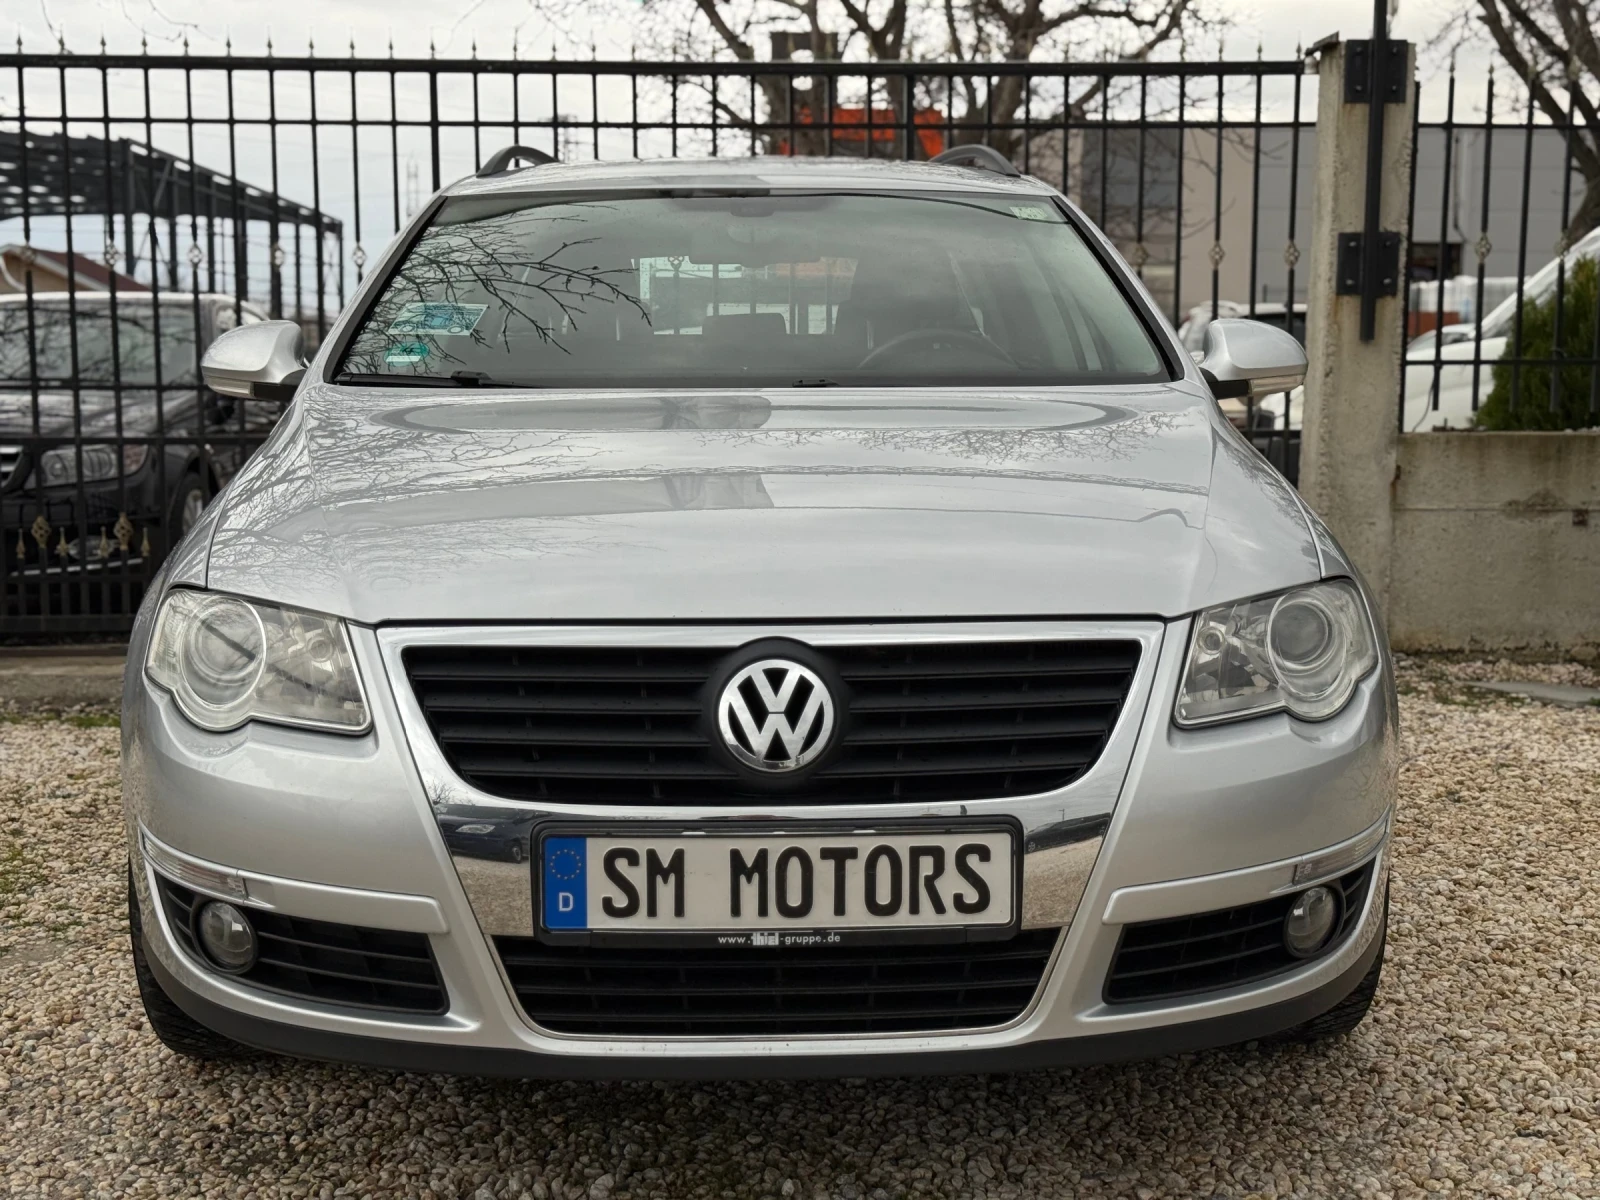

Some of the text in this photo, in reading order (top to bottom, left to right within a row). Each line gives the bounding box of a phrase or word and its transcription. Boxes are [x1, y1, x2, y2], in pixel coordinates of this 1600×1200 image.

[558, 891, 574, 912] D
[601, 843, 991, 919] SM MOTORS
